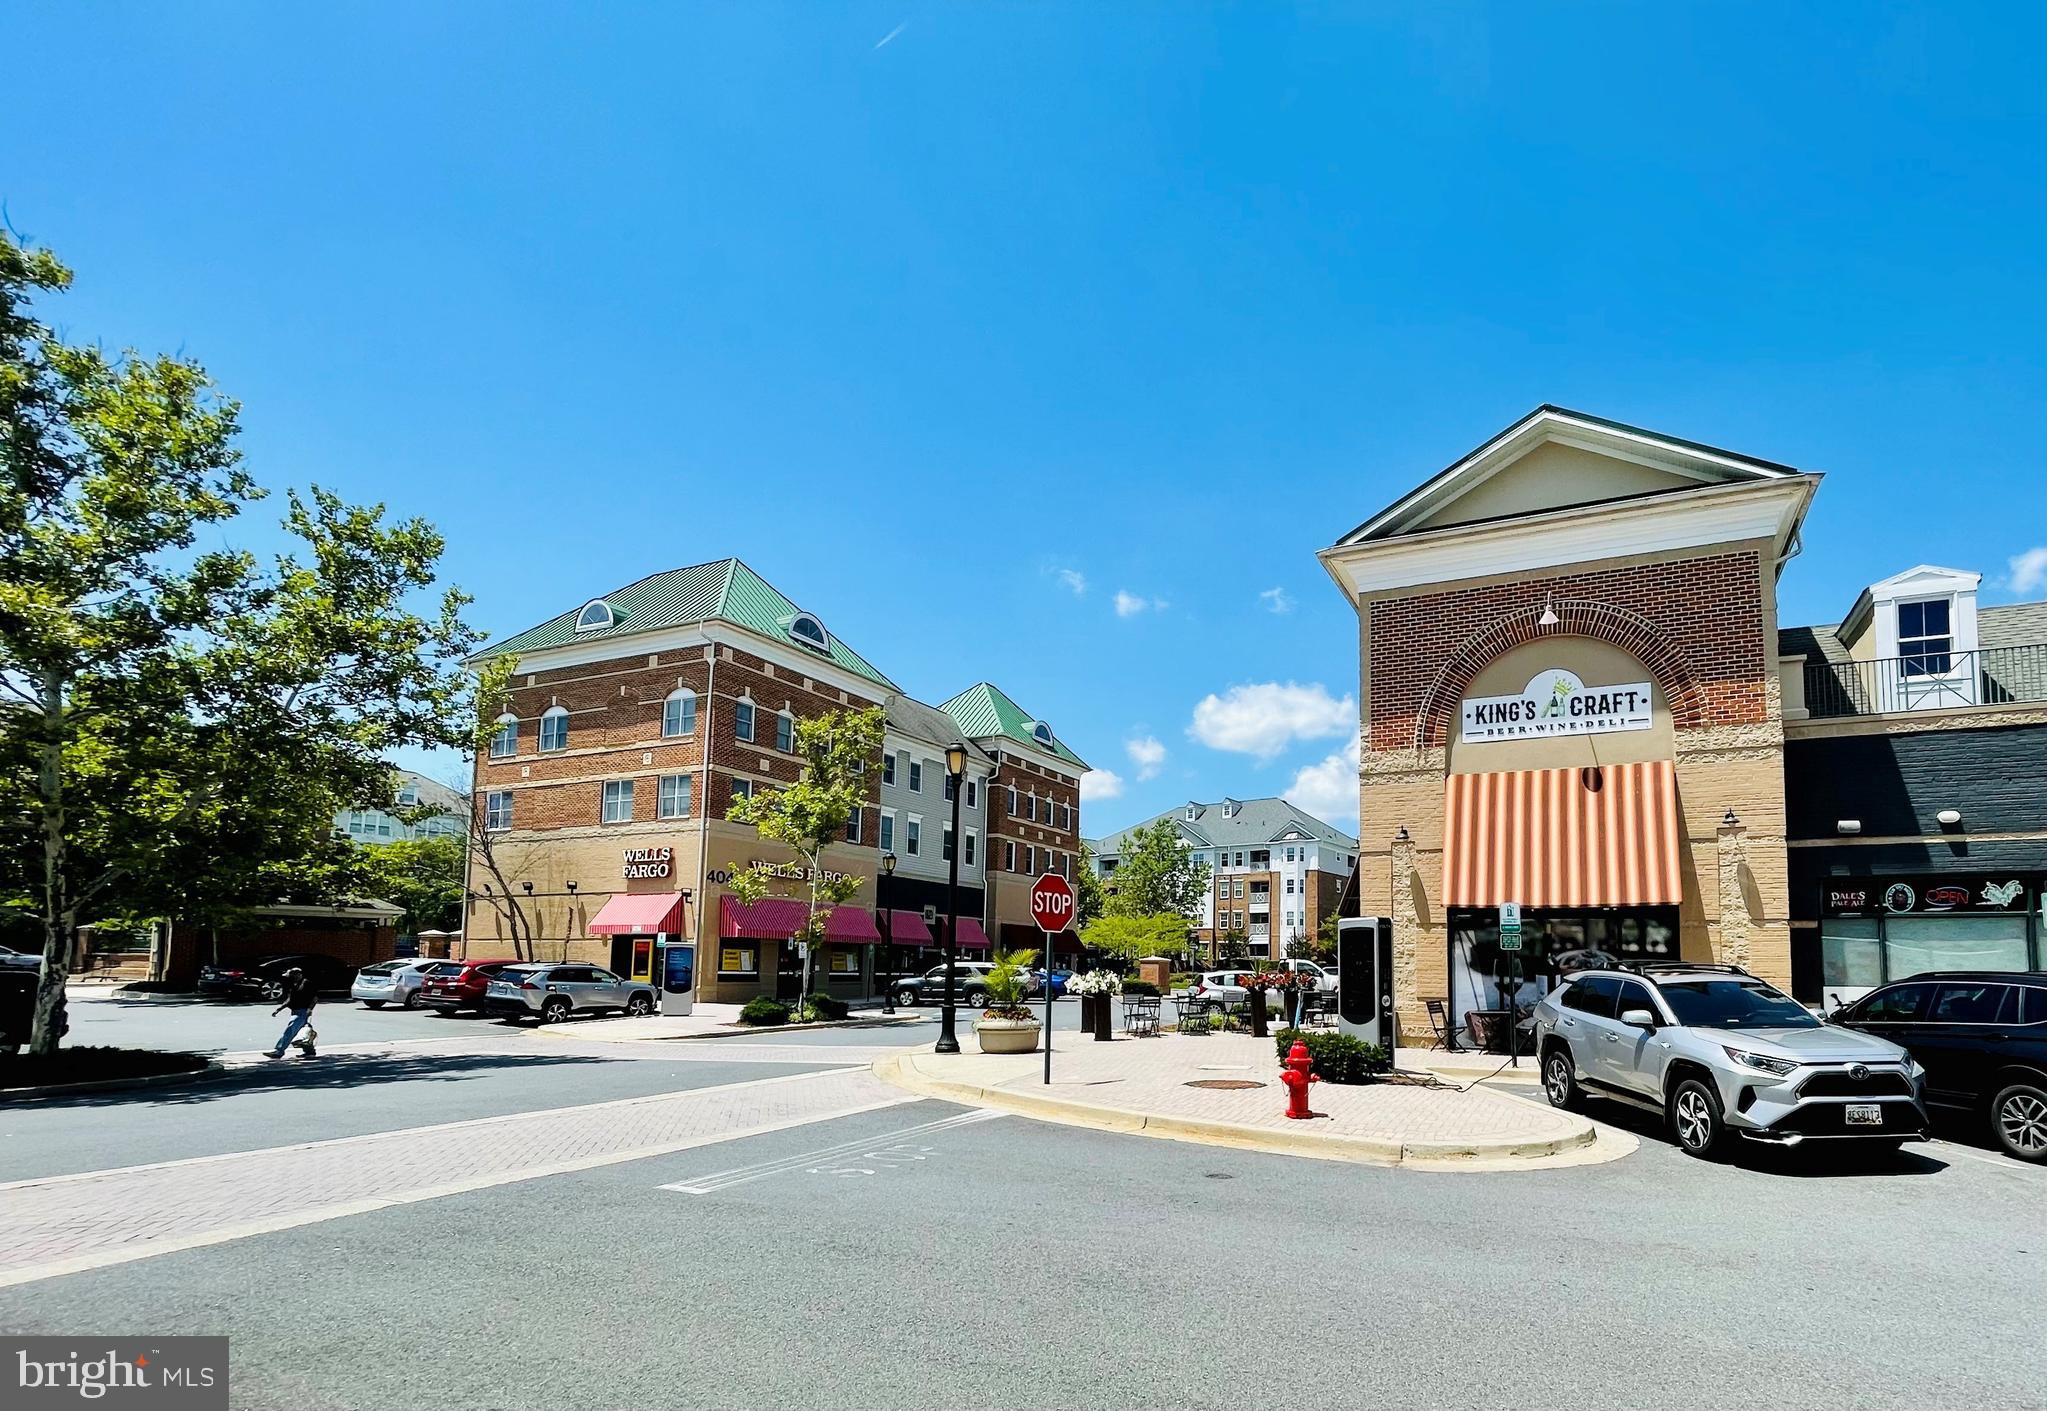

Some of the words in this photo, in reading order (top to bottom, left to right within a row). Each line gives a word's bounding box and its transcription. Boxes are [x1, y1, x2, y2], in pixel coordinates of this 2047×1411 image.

[1475, 700, 1537, 725] KING'S
[1570, 691, 1639, 717] CRAFT
[622, 847, 671, 862] WELLS
[621, 863, 669, 878] FARGO
[751, 860, 804, 880] WELLS
[1034, 890, 1071, 915] STOP
[1831, 891, 1866, 901] DALE'S
[1927, 889, 1969, 904] OPEN
